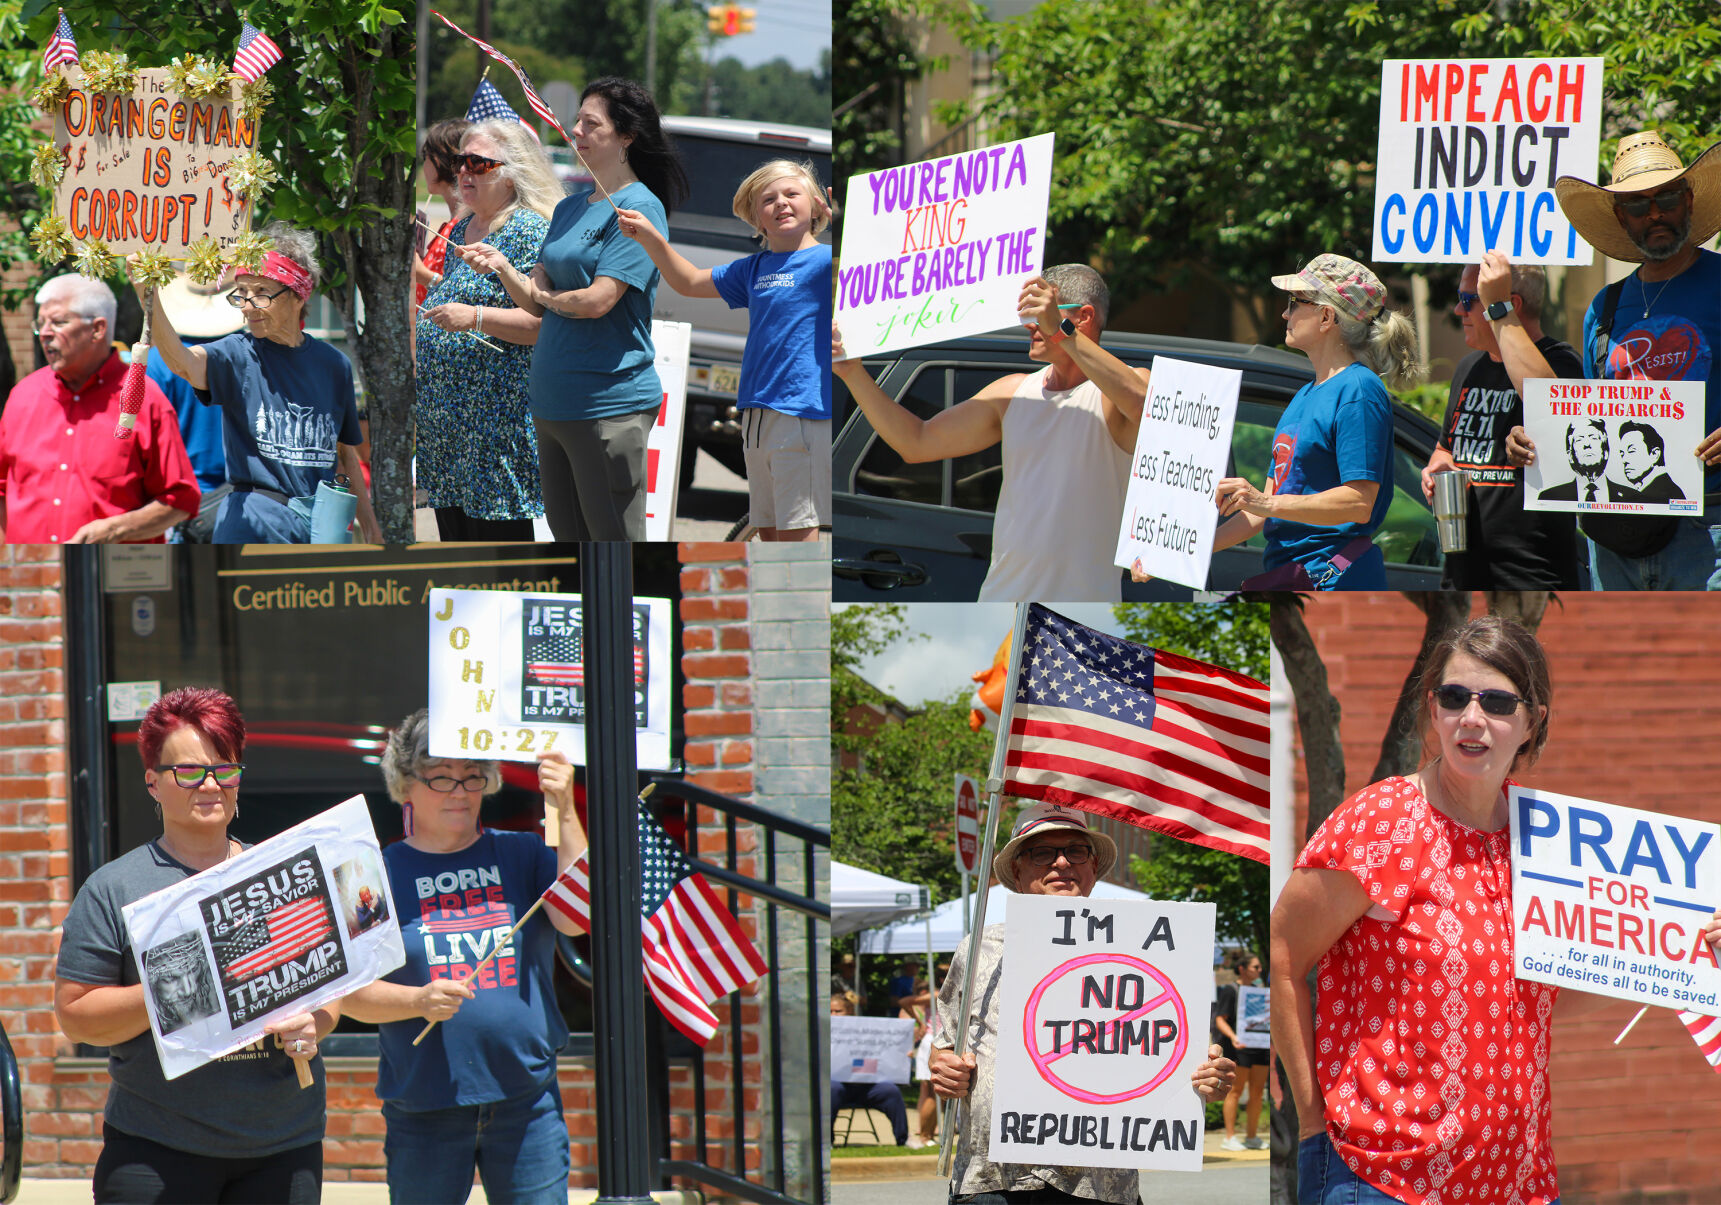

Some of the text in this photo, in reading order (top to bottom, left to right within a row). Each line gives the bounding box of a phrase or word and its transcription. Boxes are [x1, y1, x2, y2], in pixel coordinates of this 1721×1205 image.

[141, 75, 165, 93] The
[1400, 63, 1585, 123] IMPEACH
[143, 146, 171, 188] IS
[1413, 124, 1570, 189] INDICT
[869, 143, 1027, 216] YOU'RE NOT A
[901, 198, 968, 254] KING
[838, 227, 1037, 311] YOU'RE BARELY THE
[874, 294, 985, 347] joker
[1145, 385, 1221, 440] Less Funding,
[1549, 401, 1685, 421] THE OLIGARCH$
[1550, 384, 1671, 400] STOP TRUMP &
[1133, 445, 1215, 502] Less Teachers,
[1130, 506, 1197, 555] Less Future
[233, 580, 335, 611] Certified
[344, 578, 411, 607] Public
[528, 626, 575, 636] IS MY
[524, 705, 538, 715] IS
[542, 706, 564, 716] MY
[1518, 796, 1714, 889] PRAY
[211, 859, 315, 926] JESUS
[415, 865, 501, 899] BORN
[420, 885, 507, 921] FREE
[1588, 875, 1650, 911] FOR
[213, 923, 230, 938] IS
[262, 878, 320, 914] SAVIOR
[1052, 908, 1175, 951] I'M A
[424, 925, 515, 965] LIVE
[1521, 895, 1719, 968] AMERICA
[228, 941, 338, 1009] TRUMP
[429, 957, 518, 990] FREE
[1522, 956, 1719, 1007] God desires all to be saved.
[1568, 947, 1588, 963] for
[1592, 952, 1609, 967] all
[1613, 955, 1625, 971] in
[1630, 960, 1696, 985] authority.
[232, 1008, 246, 1021] IS
[249, 995, 273, 1013] MY
[273, 960, 342, 1002] PRESIDENT
[1081, 973, 1144, 1011] NO
[1043, 1018, 1177, 1056] TRUMP
[1000, 1111, 1197, 1152] REPUBLICAN
